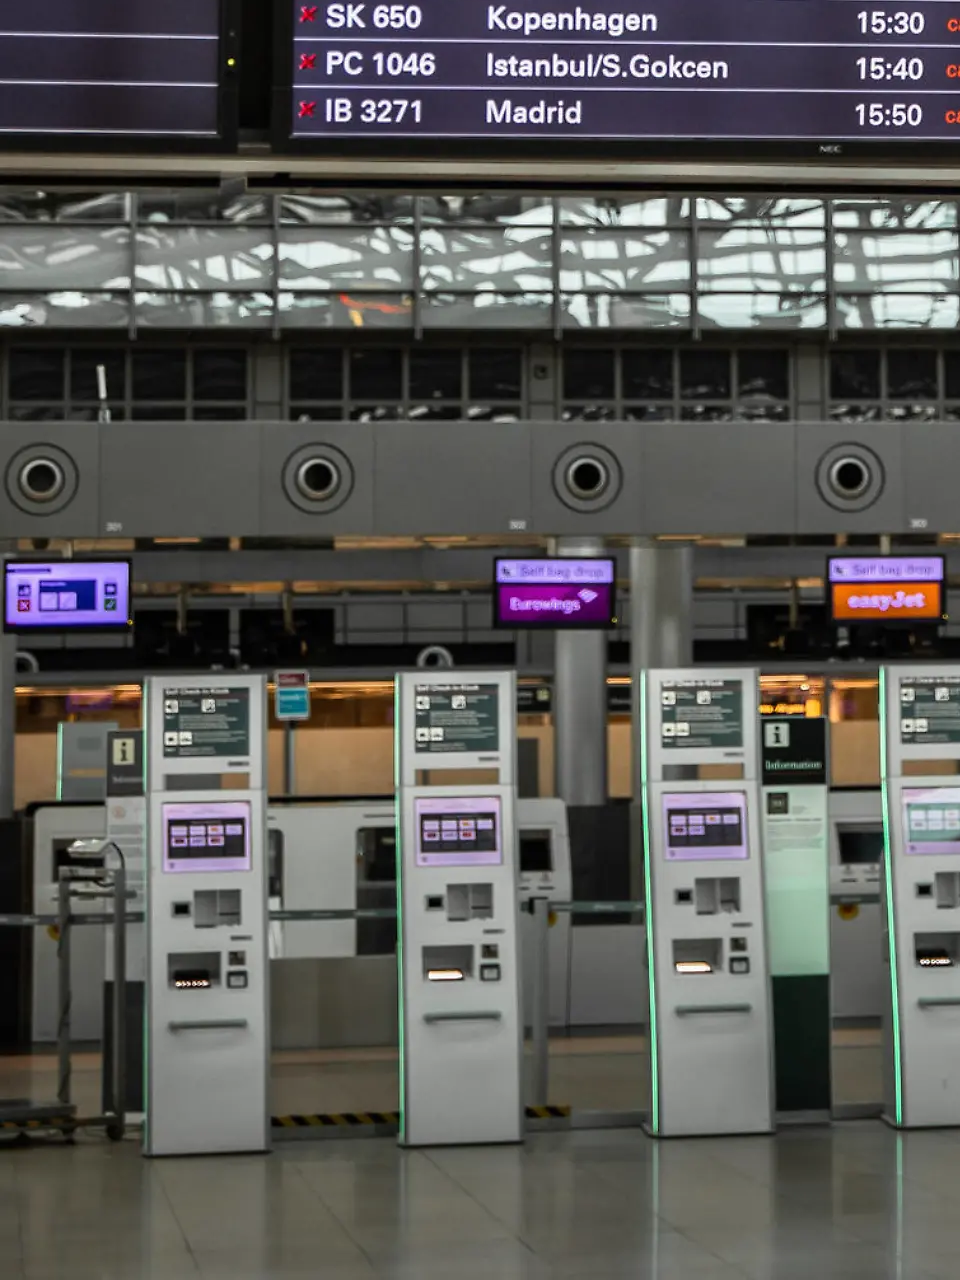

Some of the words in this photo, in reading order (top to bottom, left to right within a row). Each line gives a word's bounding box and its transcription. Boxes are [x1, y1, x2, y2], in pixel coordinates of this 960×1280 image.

[326, 50, 364, 76] PC
[372, 51, 436, 77] 1046
[486, 52, 729, 79] Istanbul/S.Gokcen
[855, 56, 924, 81] 15:40
[325, 97, 353, 123] IB
[360, 98, 422, 123] 3271
[486, 99, 582, 124] Madrid
[855, 103, 923, 127] 15:50
[818, 143, 843, 155] NEC
